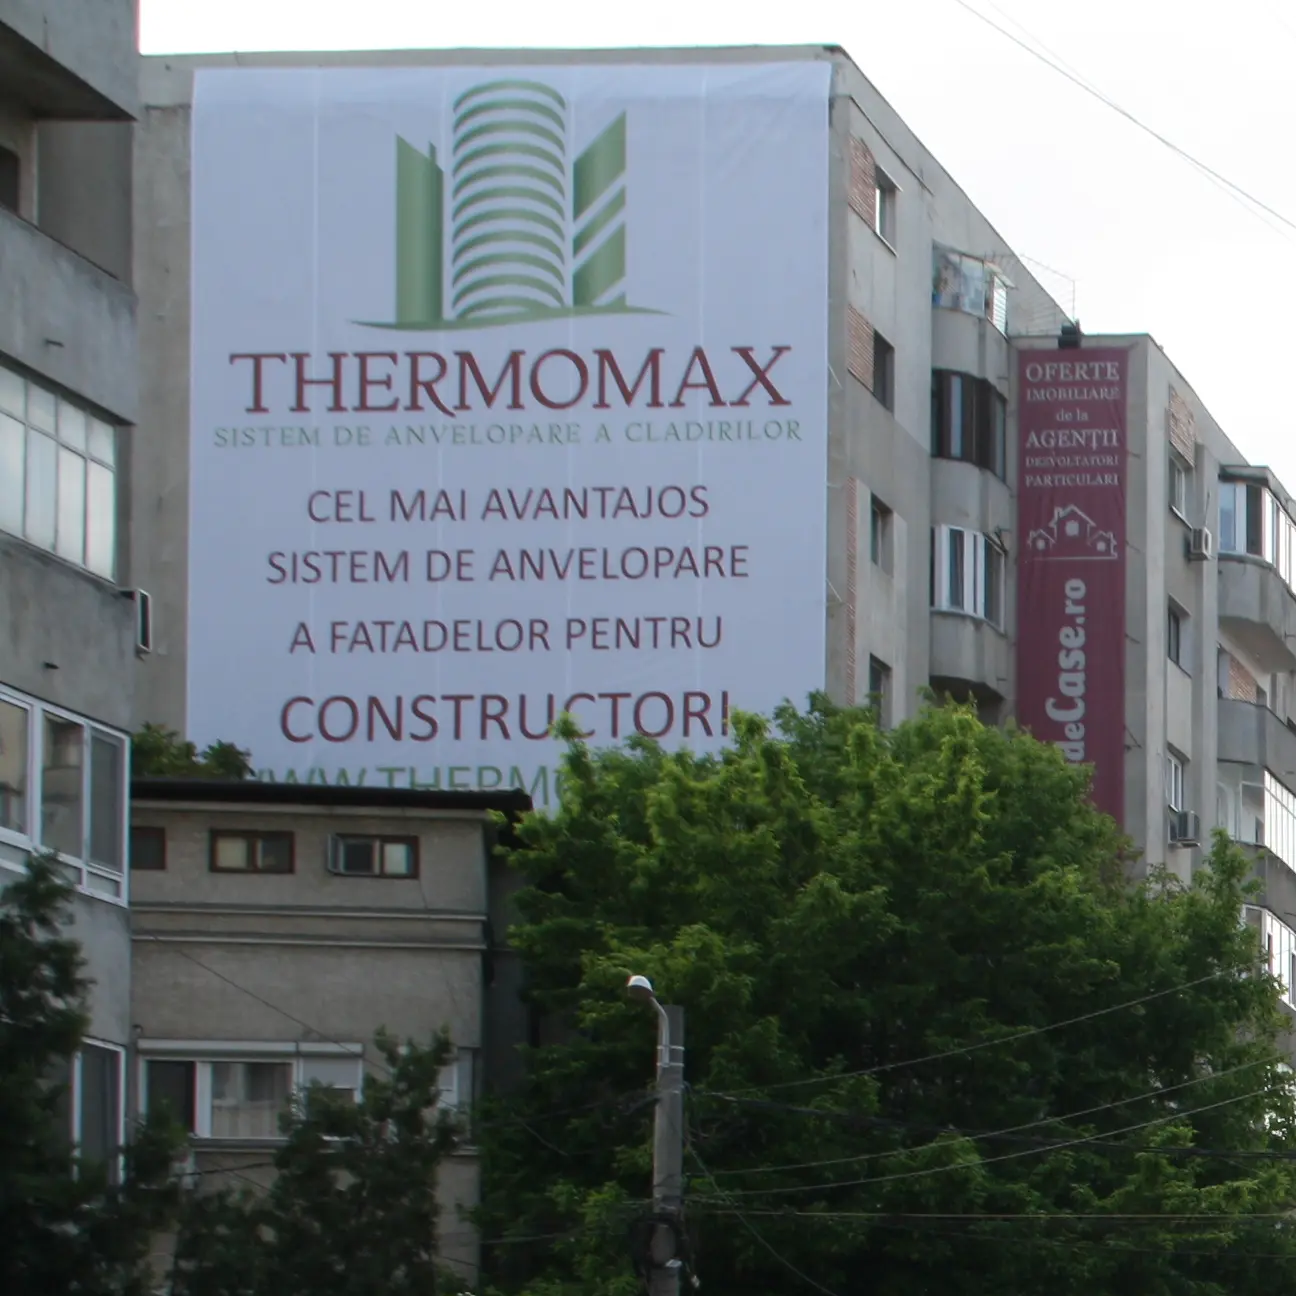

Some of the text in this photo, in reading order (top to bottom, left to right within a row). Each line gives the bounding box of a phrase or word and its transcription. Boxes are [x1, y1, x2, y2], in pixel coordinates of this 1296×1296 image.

[229, 345, 792, 417] THERMOMAX
[1025, 361, 1120, 382] OFERTE
[1026, 387, 1120, 401] IMOBILIARE
[1056, 408, 1089, 421] de la
[213, 419, 803, 448] SISTEM DE ANVELOPARE A CLADIRILOR
[1025, 473, 1119, 487] PARTICULARI
[306, 484, 709, 524] CEL MAI AVANTAJOS
[266, 545, 749, 584] SISTEM DE ANVELOPARE
[289, 615, 724, 654] A FATADELOR PENTRU
[280, 690, 730, 743] CONSTRUCTORI
